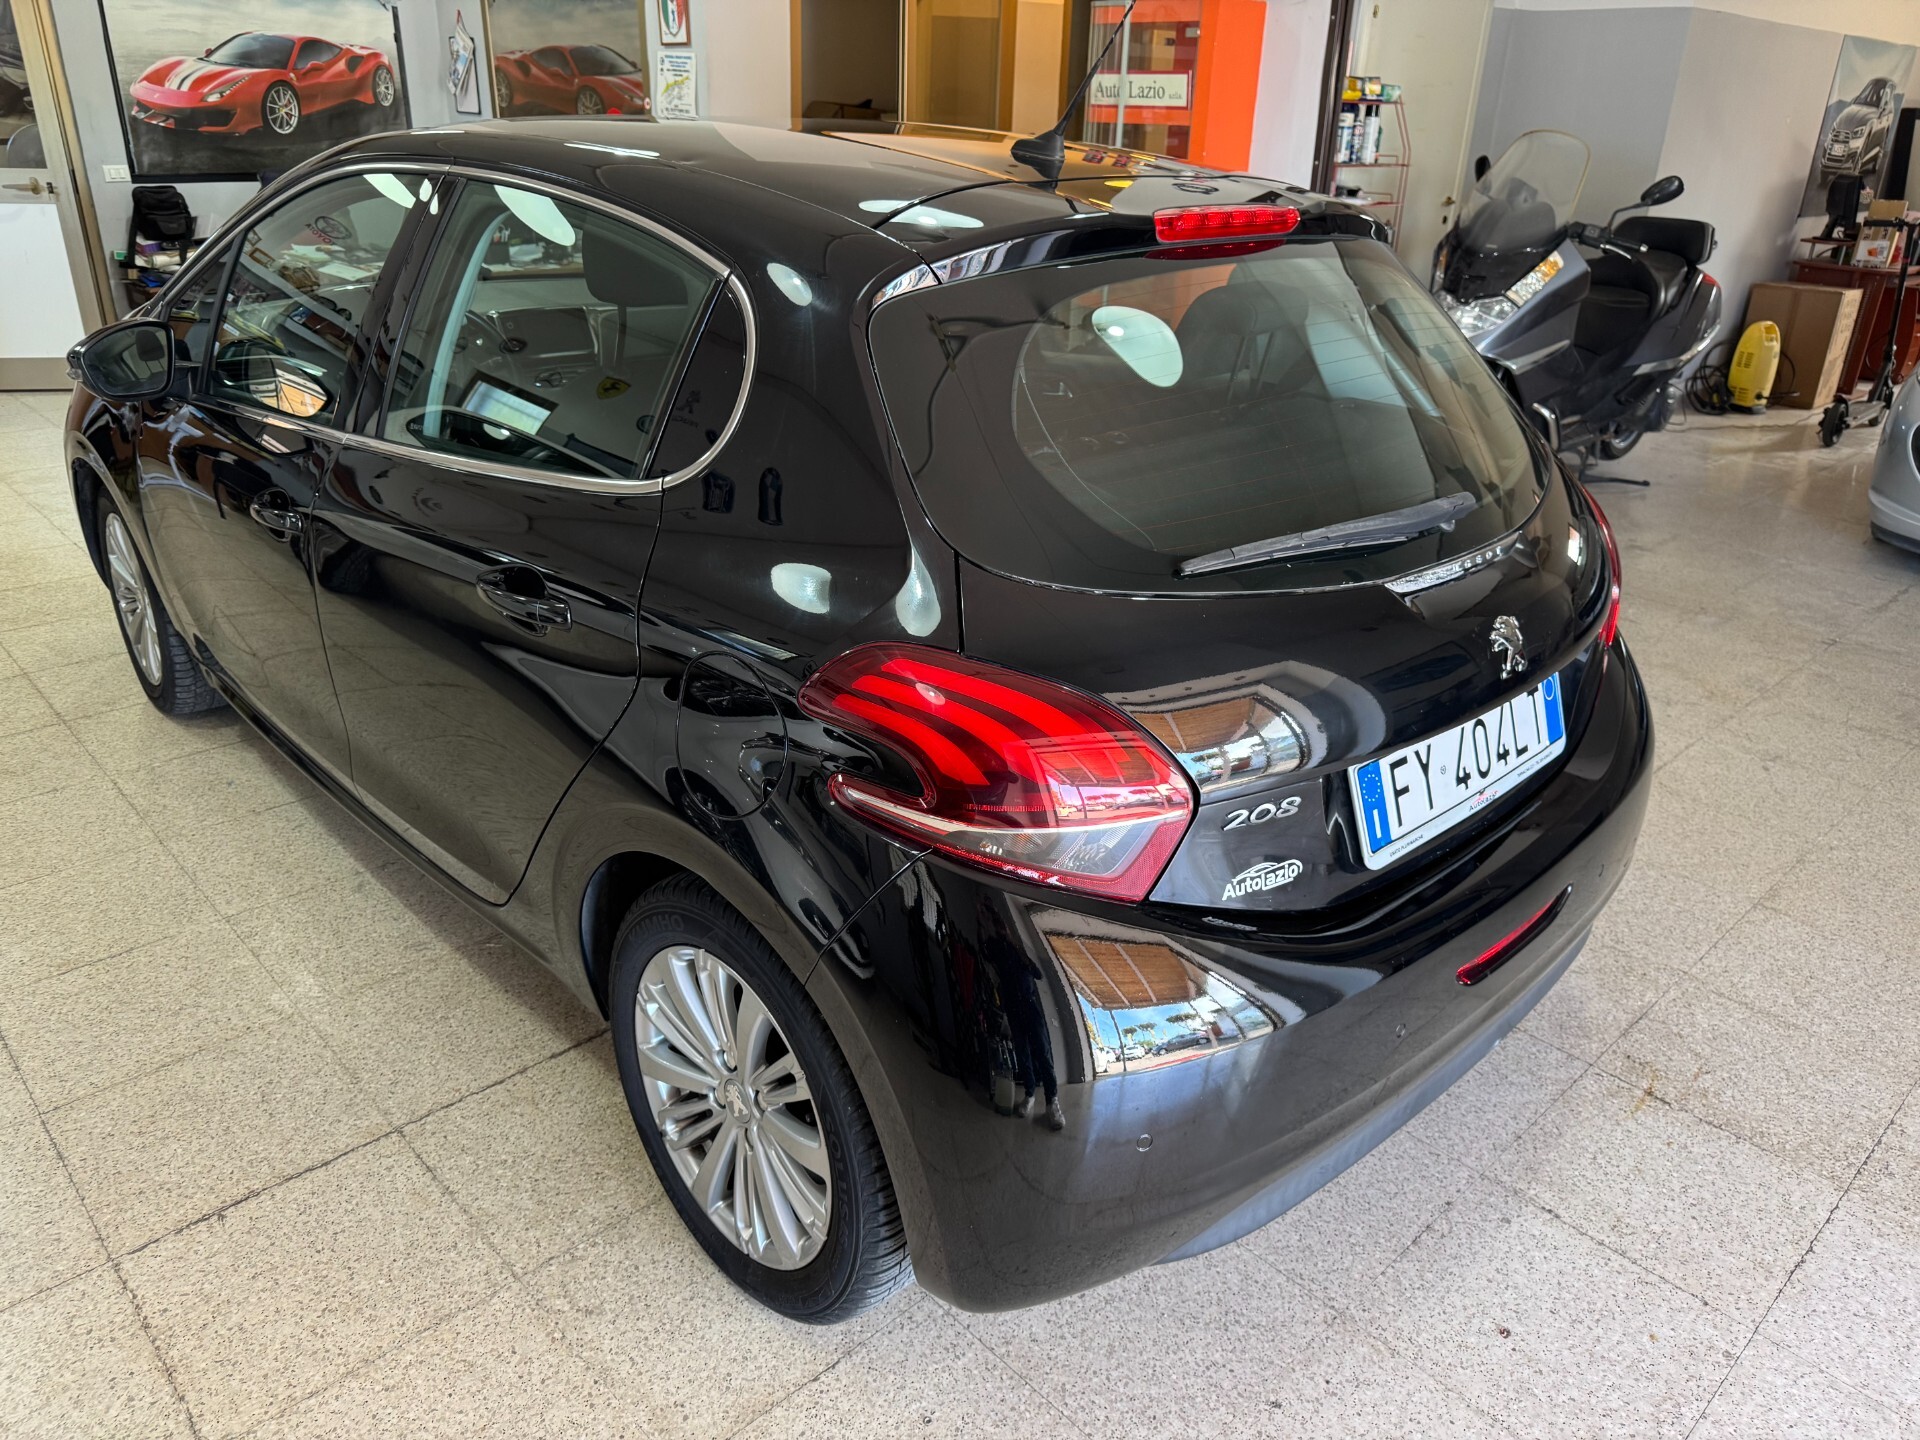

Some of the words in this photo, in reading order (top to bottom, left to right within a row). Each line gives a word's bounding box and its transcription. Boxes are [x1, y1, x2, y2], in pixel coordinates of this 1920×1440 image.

[1128, 80, 1166, 99] Lazio
[1388, 742, 1434, 829] FY
[1454, 684, 1542, 791] 404LT
[1222, 796, 1302, 831] 208
[1222, 862, 1300, 901] Autolazio
[627, 913, 685, 946] KUMHO
[822, 1112, 849, 1220] SOLUS
